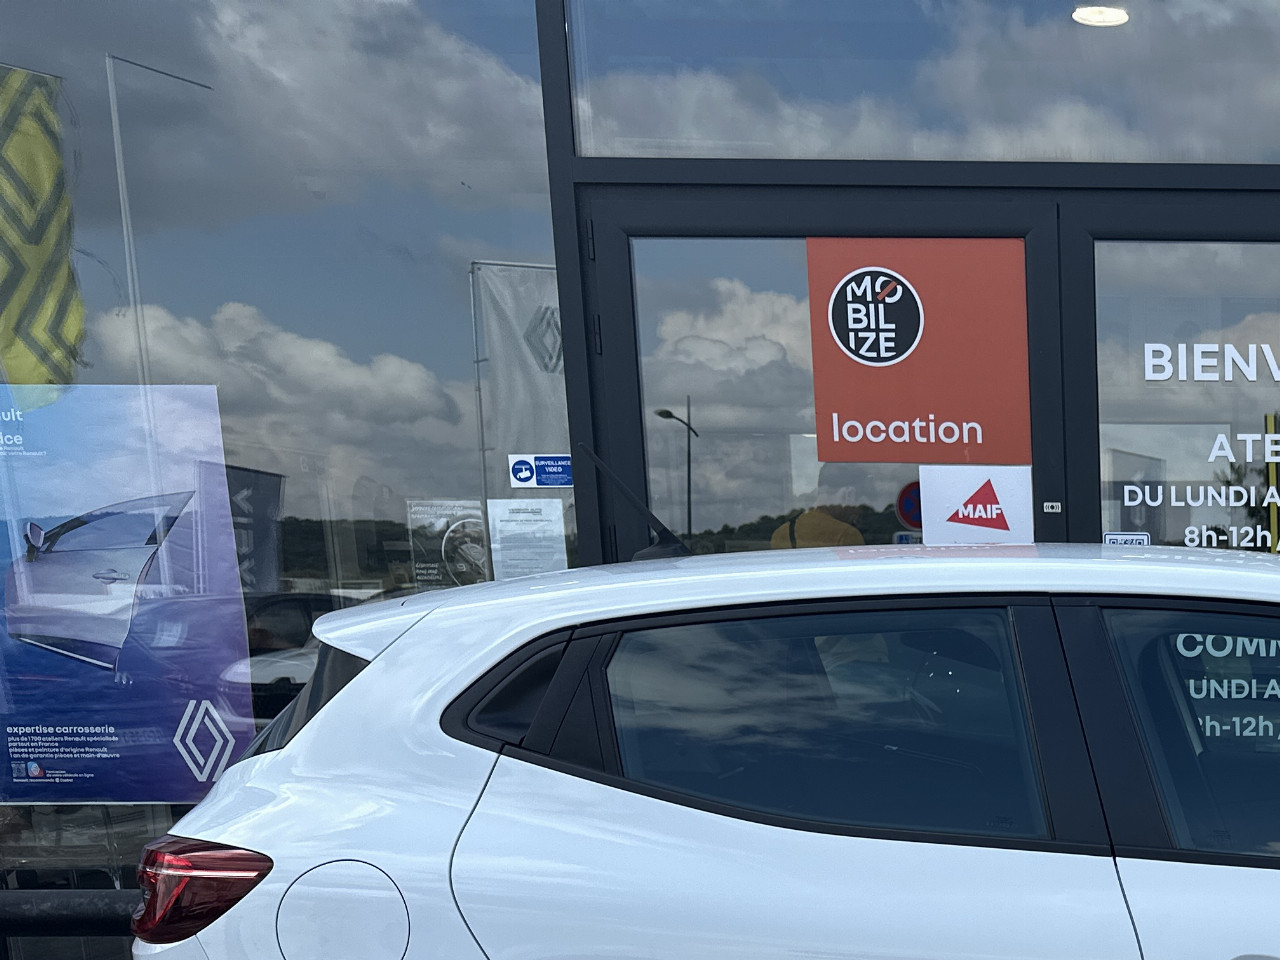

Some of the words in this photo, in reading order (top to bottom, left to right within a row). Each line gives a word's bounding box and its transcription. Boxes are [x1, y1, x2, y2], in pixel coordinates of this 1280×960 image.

[832, 412, 983, 444] location
[1124, 485, 1162, 507] DU
[1170, 485, 1255, 507] LUNDI
[958, 504, 1002, 518] MAIF
[1184, 525, 1271, 548] 8h-12h
[1189, 678, 1257, 699] UNDI
[6, 724, 54, 735] expertise
[55, 724, 115, 734] carrosserie
[1198, 716, 1274, 737] h-12h
